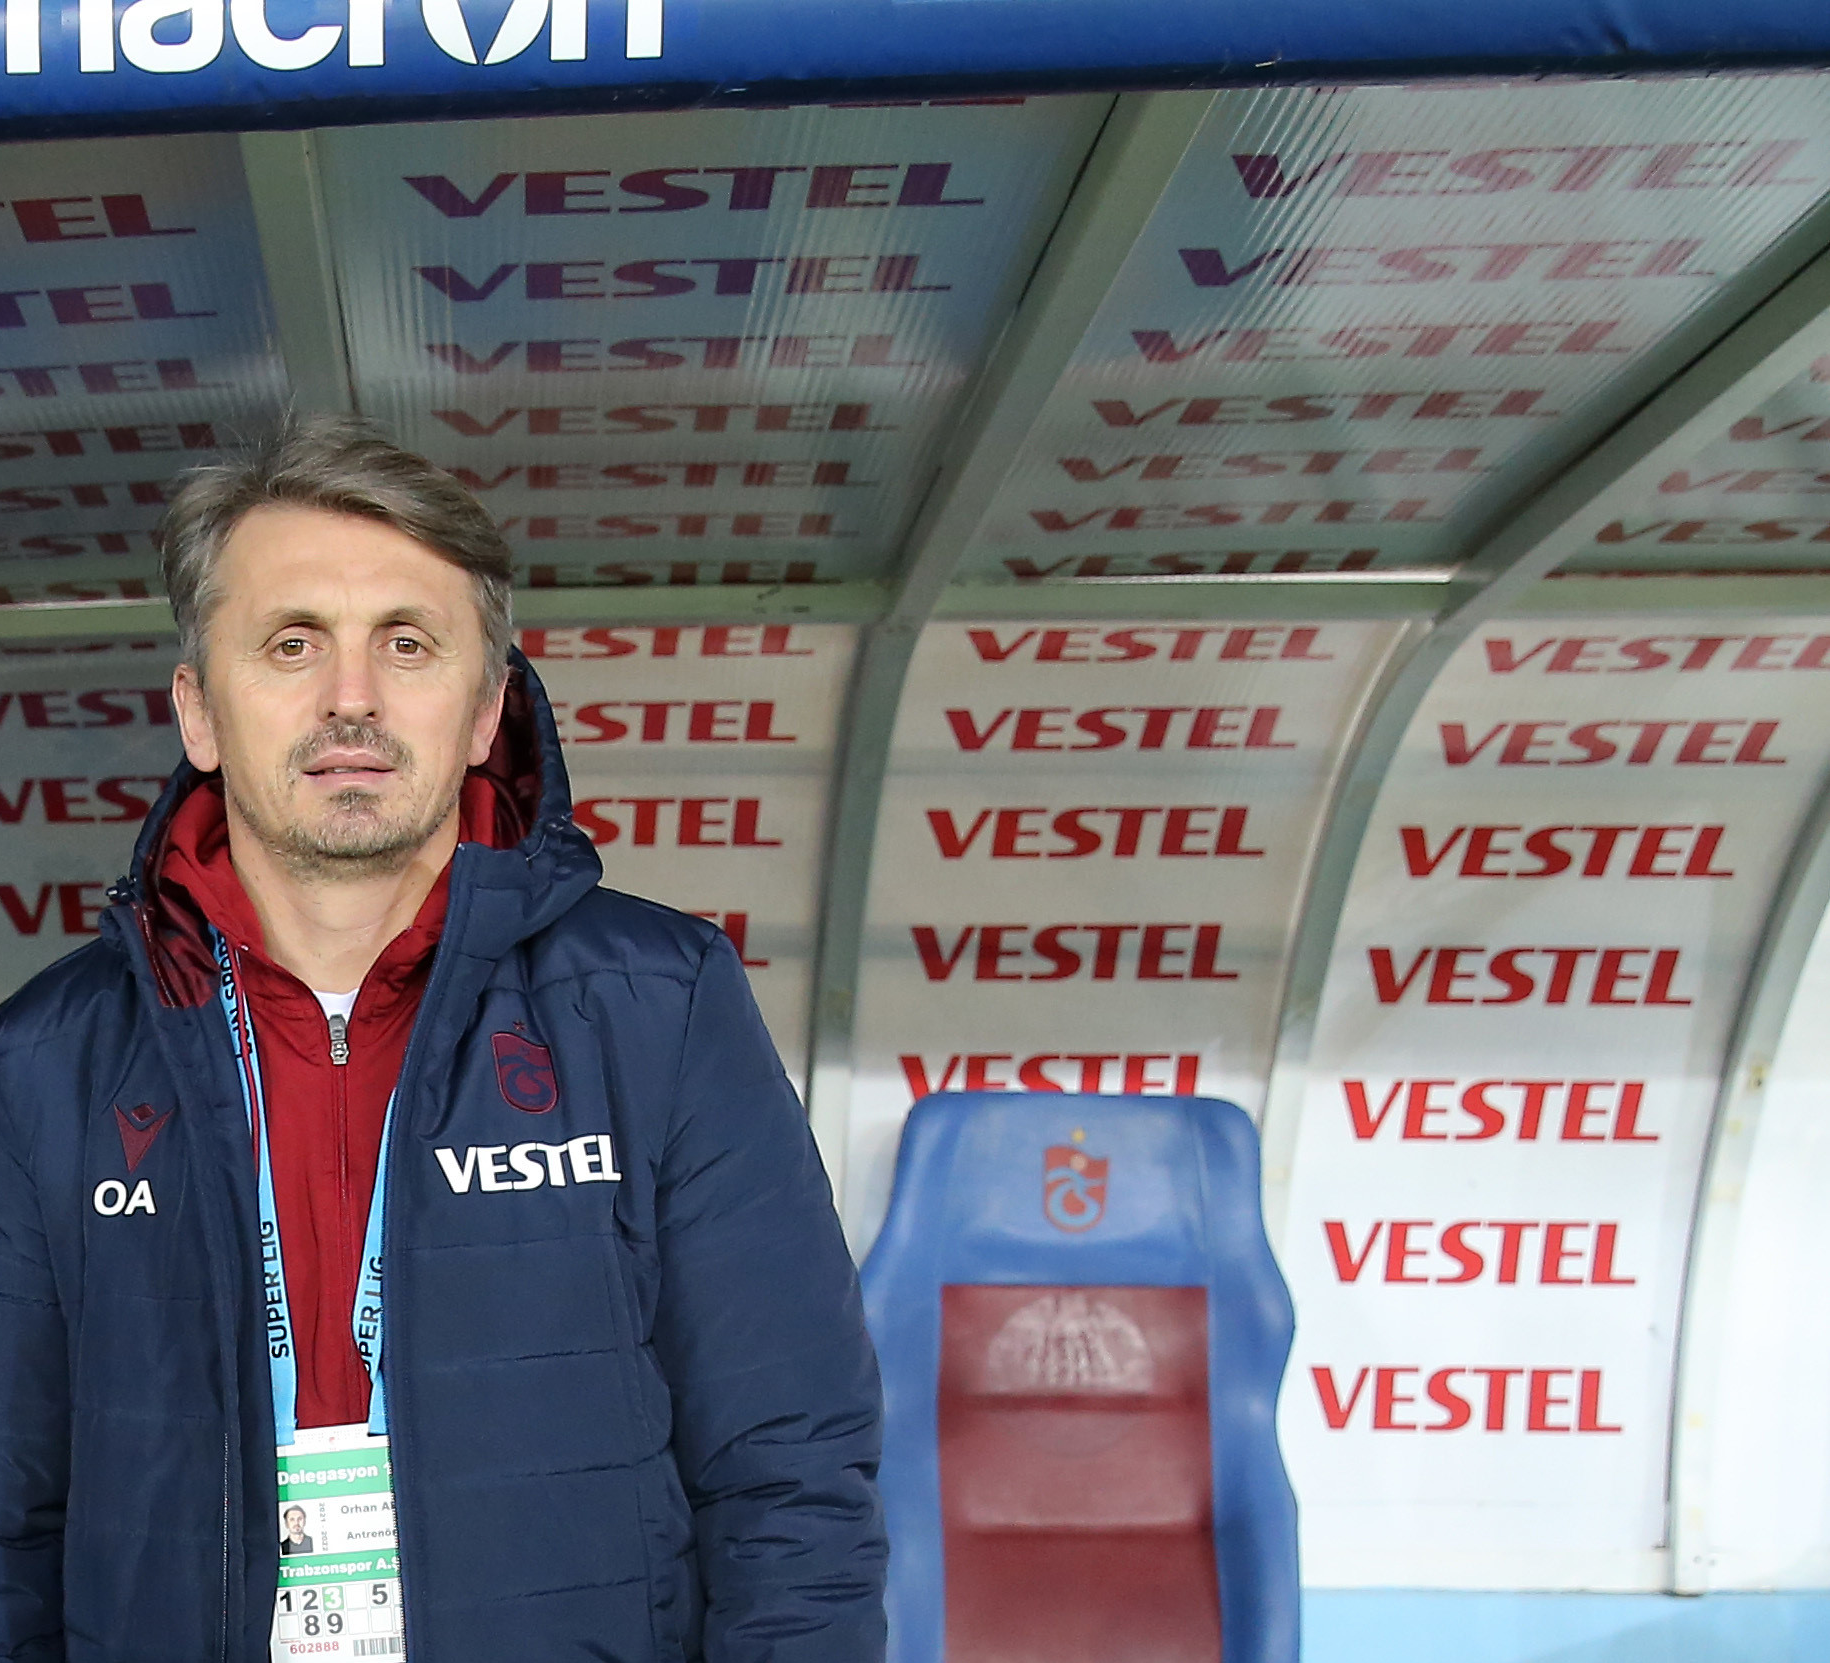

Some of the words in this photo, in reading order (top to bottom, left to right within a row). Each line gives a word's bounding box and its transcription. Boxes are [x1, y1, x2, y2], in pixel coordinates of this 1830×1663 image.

[403, 162, 984, 218] VESTEL
[1231, 137, 1818, 199] VESTEL
[412, 255, 952, 302] VESTEL
[1178, 237, 1716, 289] VESTEL
[426, 333, 928, 375] VESTEL
[1131, 319, 1635, 365] VESTEL
[430, 403, 899, 437] VESTEL
[1092, 388, 1561, 428] VESTEL
[1057, 445, 1491, 483] VESTEL
[1028, 498, 1446, 533] VESTEL
[515, 560, 838, 590] ESTEL
[1002, 546, 1382, 582] VESTEL
[514, 625, 815, 661] ESTEL
[966, 625, 1334, 664] VESTEL
[554, 700, 798, 745] STEL
[945, 706, 1297, 753] VESTEL
[1439, 720, 1787, 767] VESTEL
[571, 796, 783, 847] STEL
[926, 806, 1265, 860] VESTEL
[1399, 824, 1734, 879] VESTEL
[910, 923, 1239, 982] VESTEL
[1366, 947, 1693, 1006] VESTEL
[1341, 1078, 1660, 1143] VESTEL
[433, 1134, 623, 1194] VESTEL
[93, 1179, 157, 1217] OA
[1323, 1220, 1637, 1285] VESTEL
[1310, 1365, 1623, 1432] VESTEL
[277, 1464, 378, 1487] Delegasyon
[340, 1503, 377, 1515] Orhan
[279, 1560, 372, 1579] Trabzonspor
[280, 1590, 292, 1612] 1
[302, 1589, 319, 1611] 2
[325, 1587, 342, 1609] 3
[372, 1584, 388, 1605] 5
[304, 1614, 320, 1636] 8
[326, 1612, 343, 1634] 9
